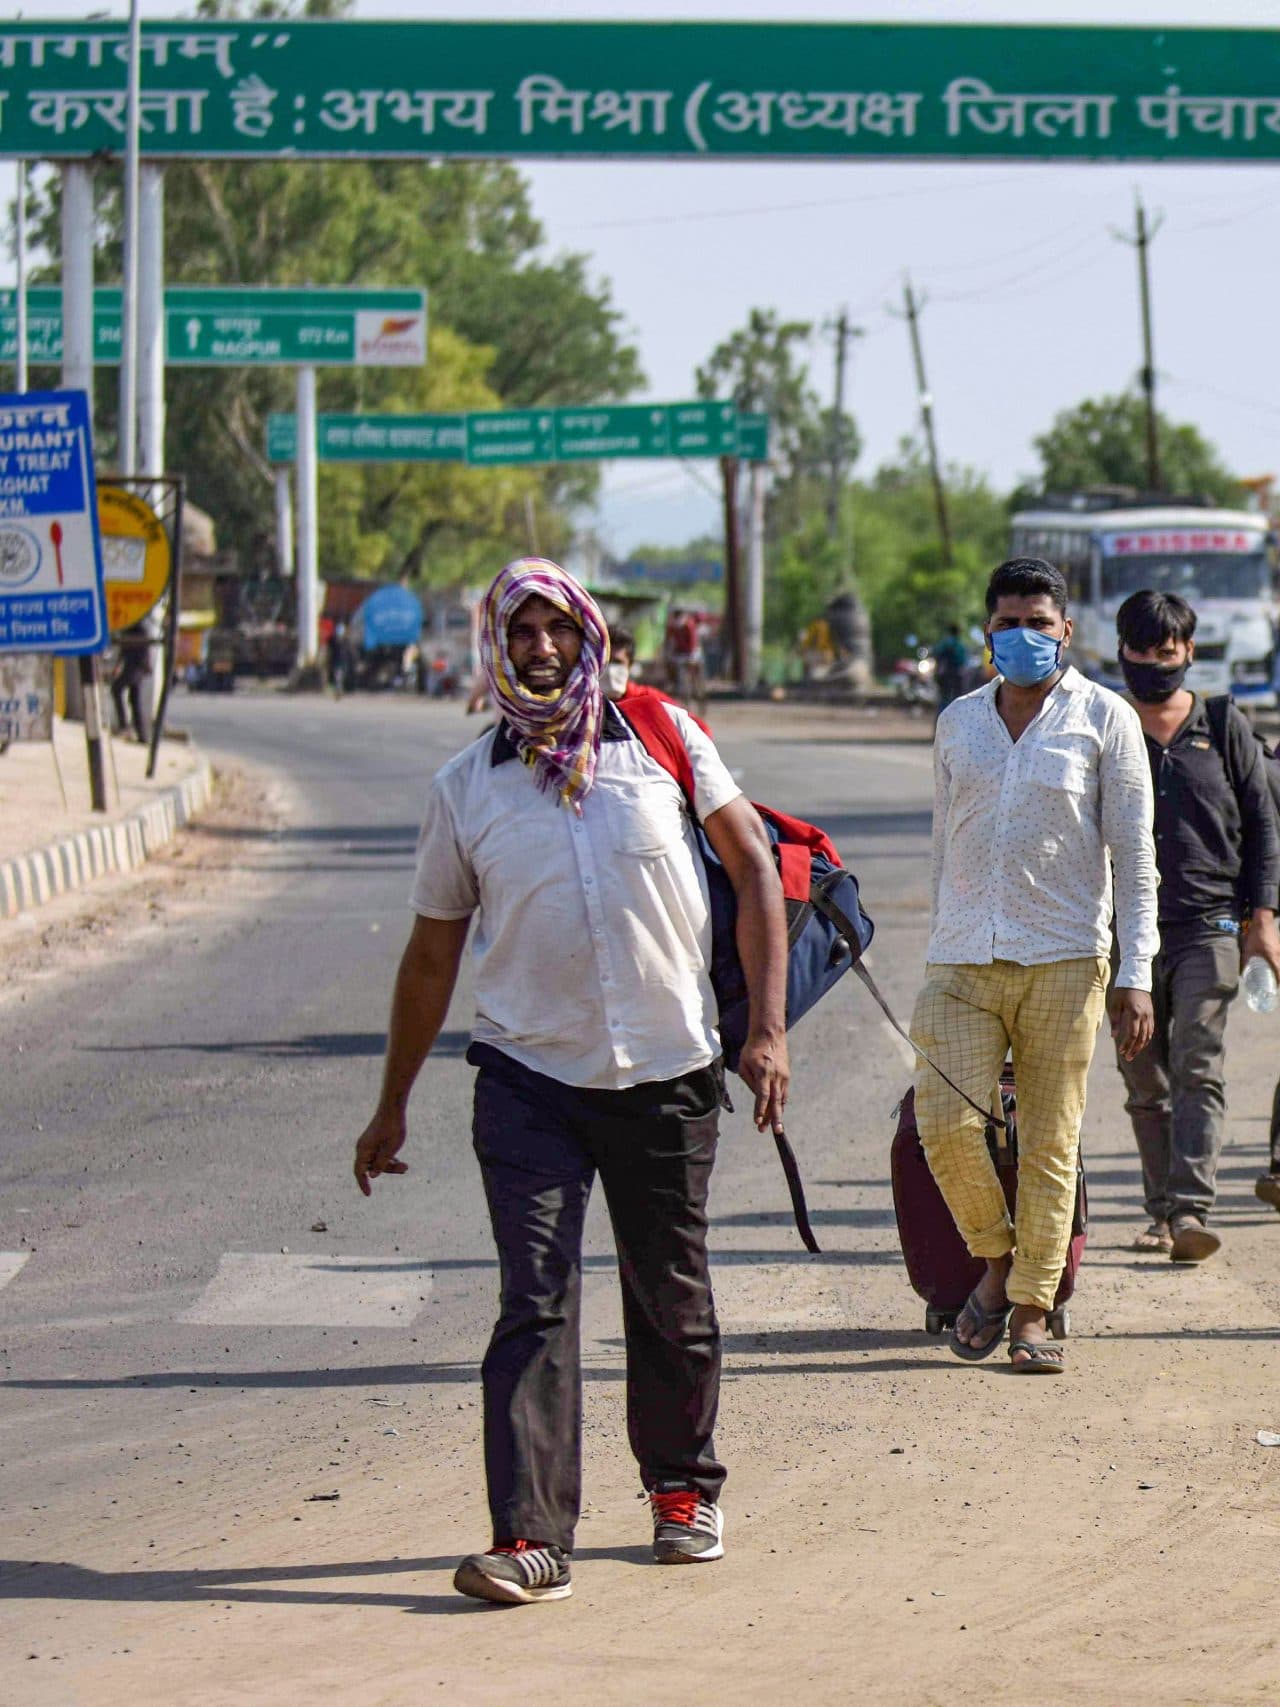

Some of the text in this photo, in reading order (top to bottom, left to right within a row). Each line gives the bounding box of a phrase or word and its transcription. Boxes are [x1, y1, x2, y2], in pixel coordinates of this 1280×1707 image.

[27, 88, 209, 135] करता
[514, 74, 674, 136] मिश्रा
[941, 77, 1118, 139] जिला
[16, 451, 72, 472] TREAT
